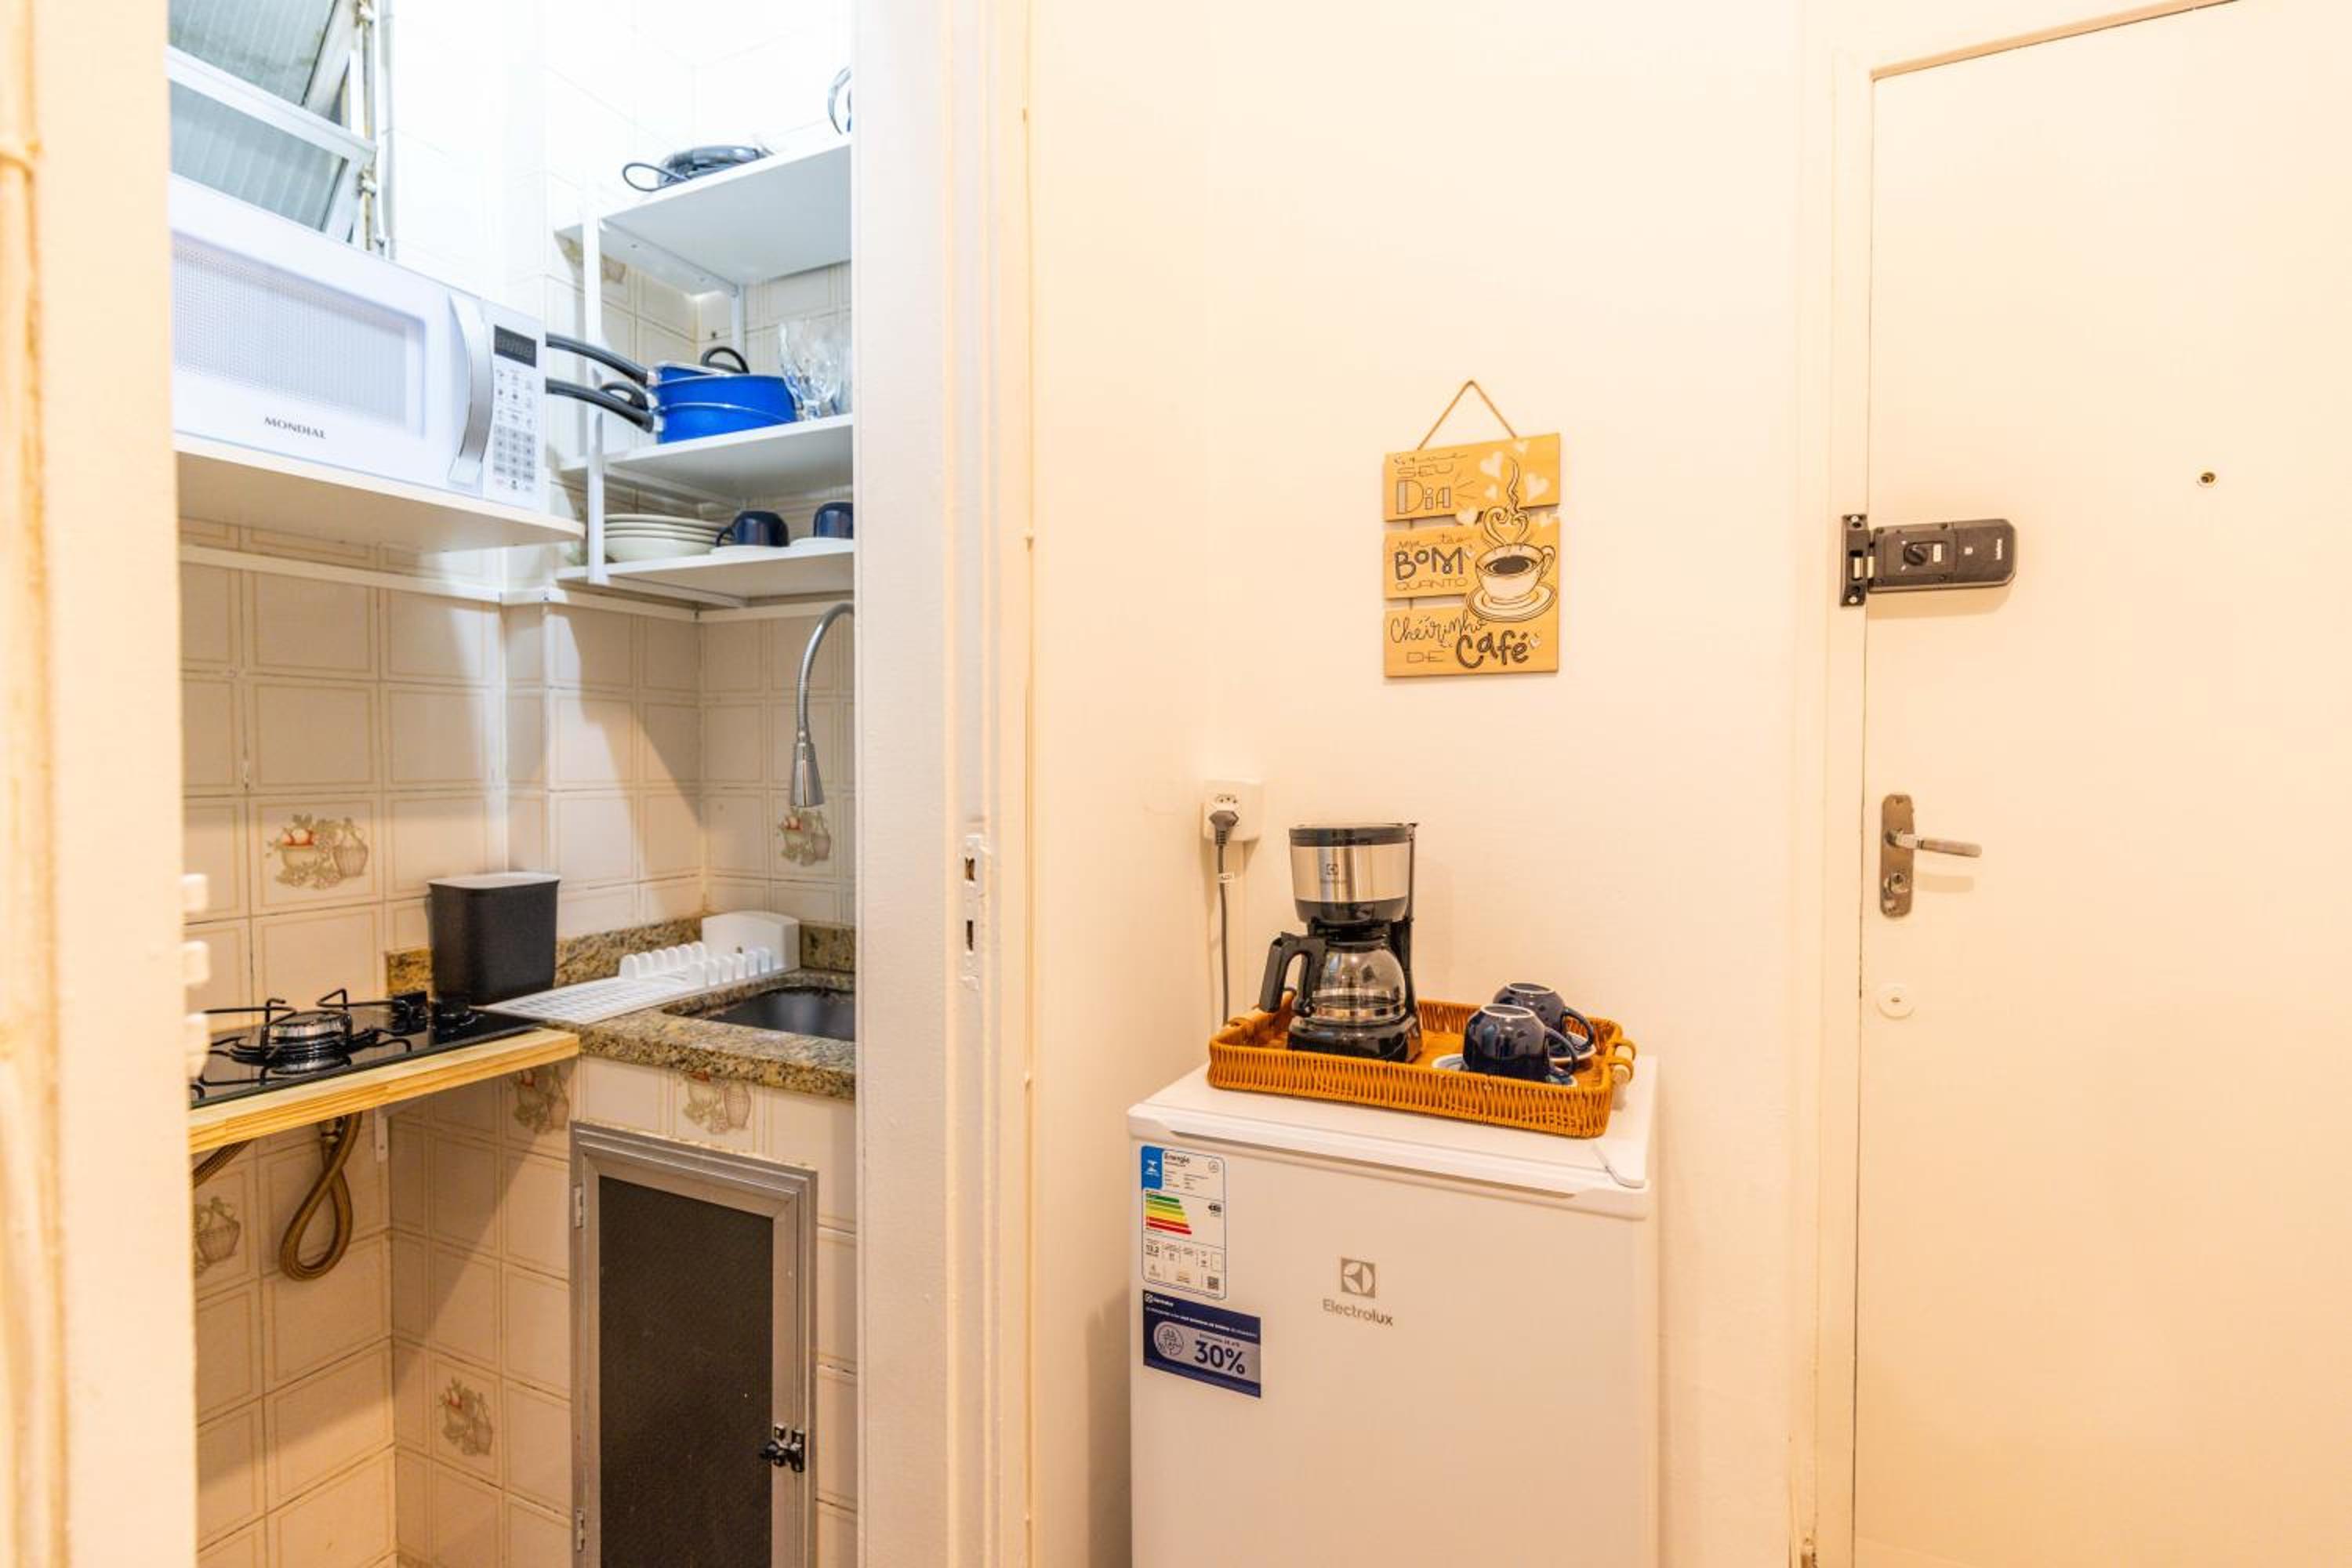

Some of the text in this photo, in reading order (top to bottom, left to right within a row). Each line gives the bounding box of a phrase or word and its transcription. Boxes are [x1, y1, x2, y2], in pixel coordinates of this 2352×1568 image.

[264, 416, 327, 440] MONDIAL
[1397, 463, 1454, 477] SEU
[1396, 577, 1468, 591] QUANTO
[1456, 630, 1528, 669] Café
[1322, 1298, 1393, 1327] Electrolux
[1194, 1340, 1246, 1374] 30%
